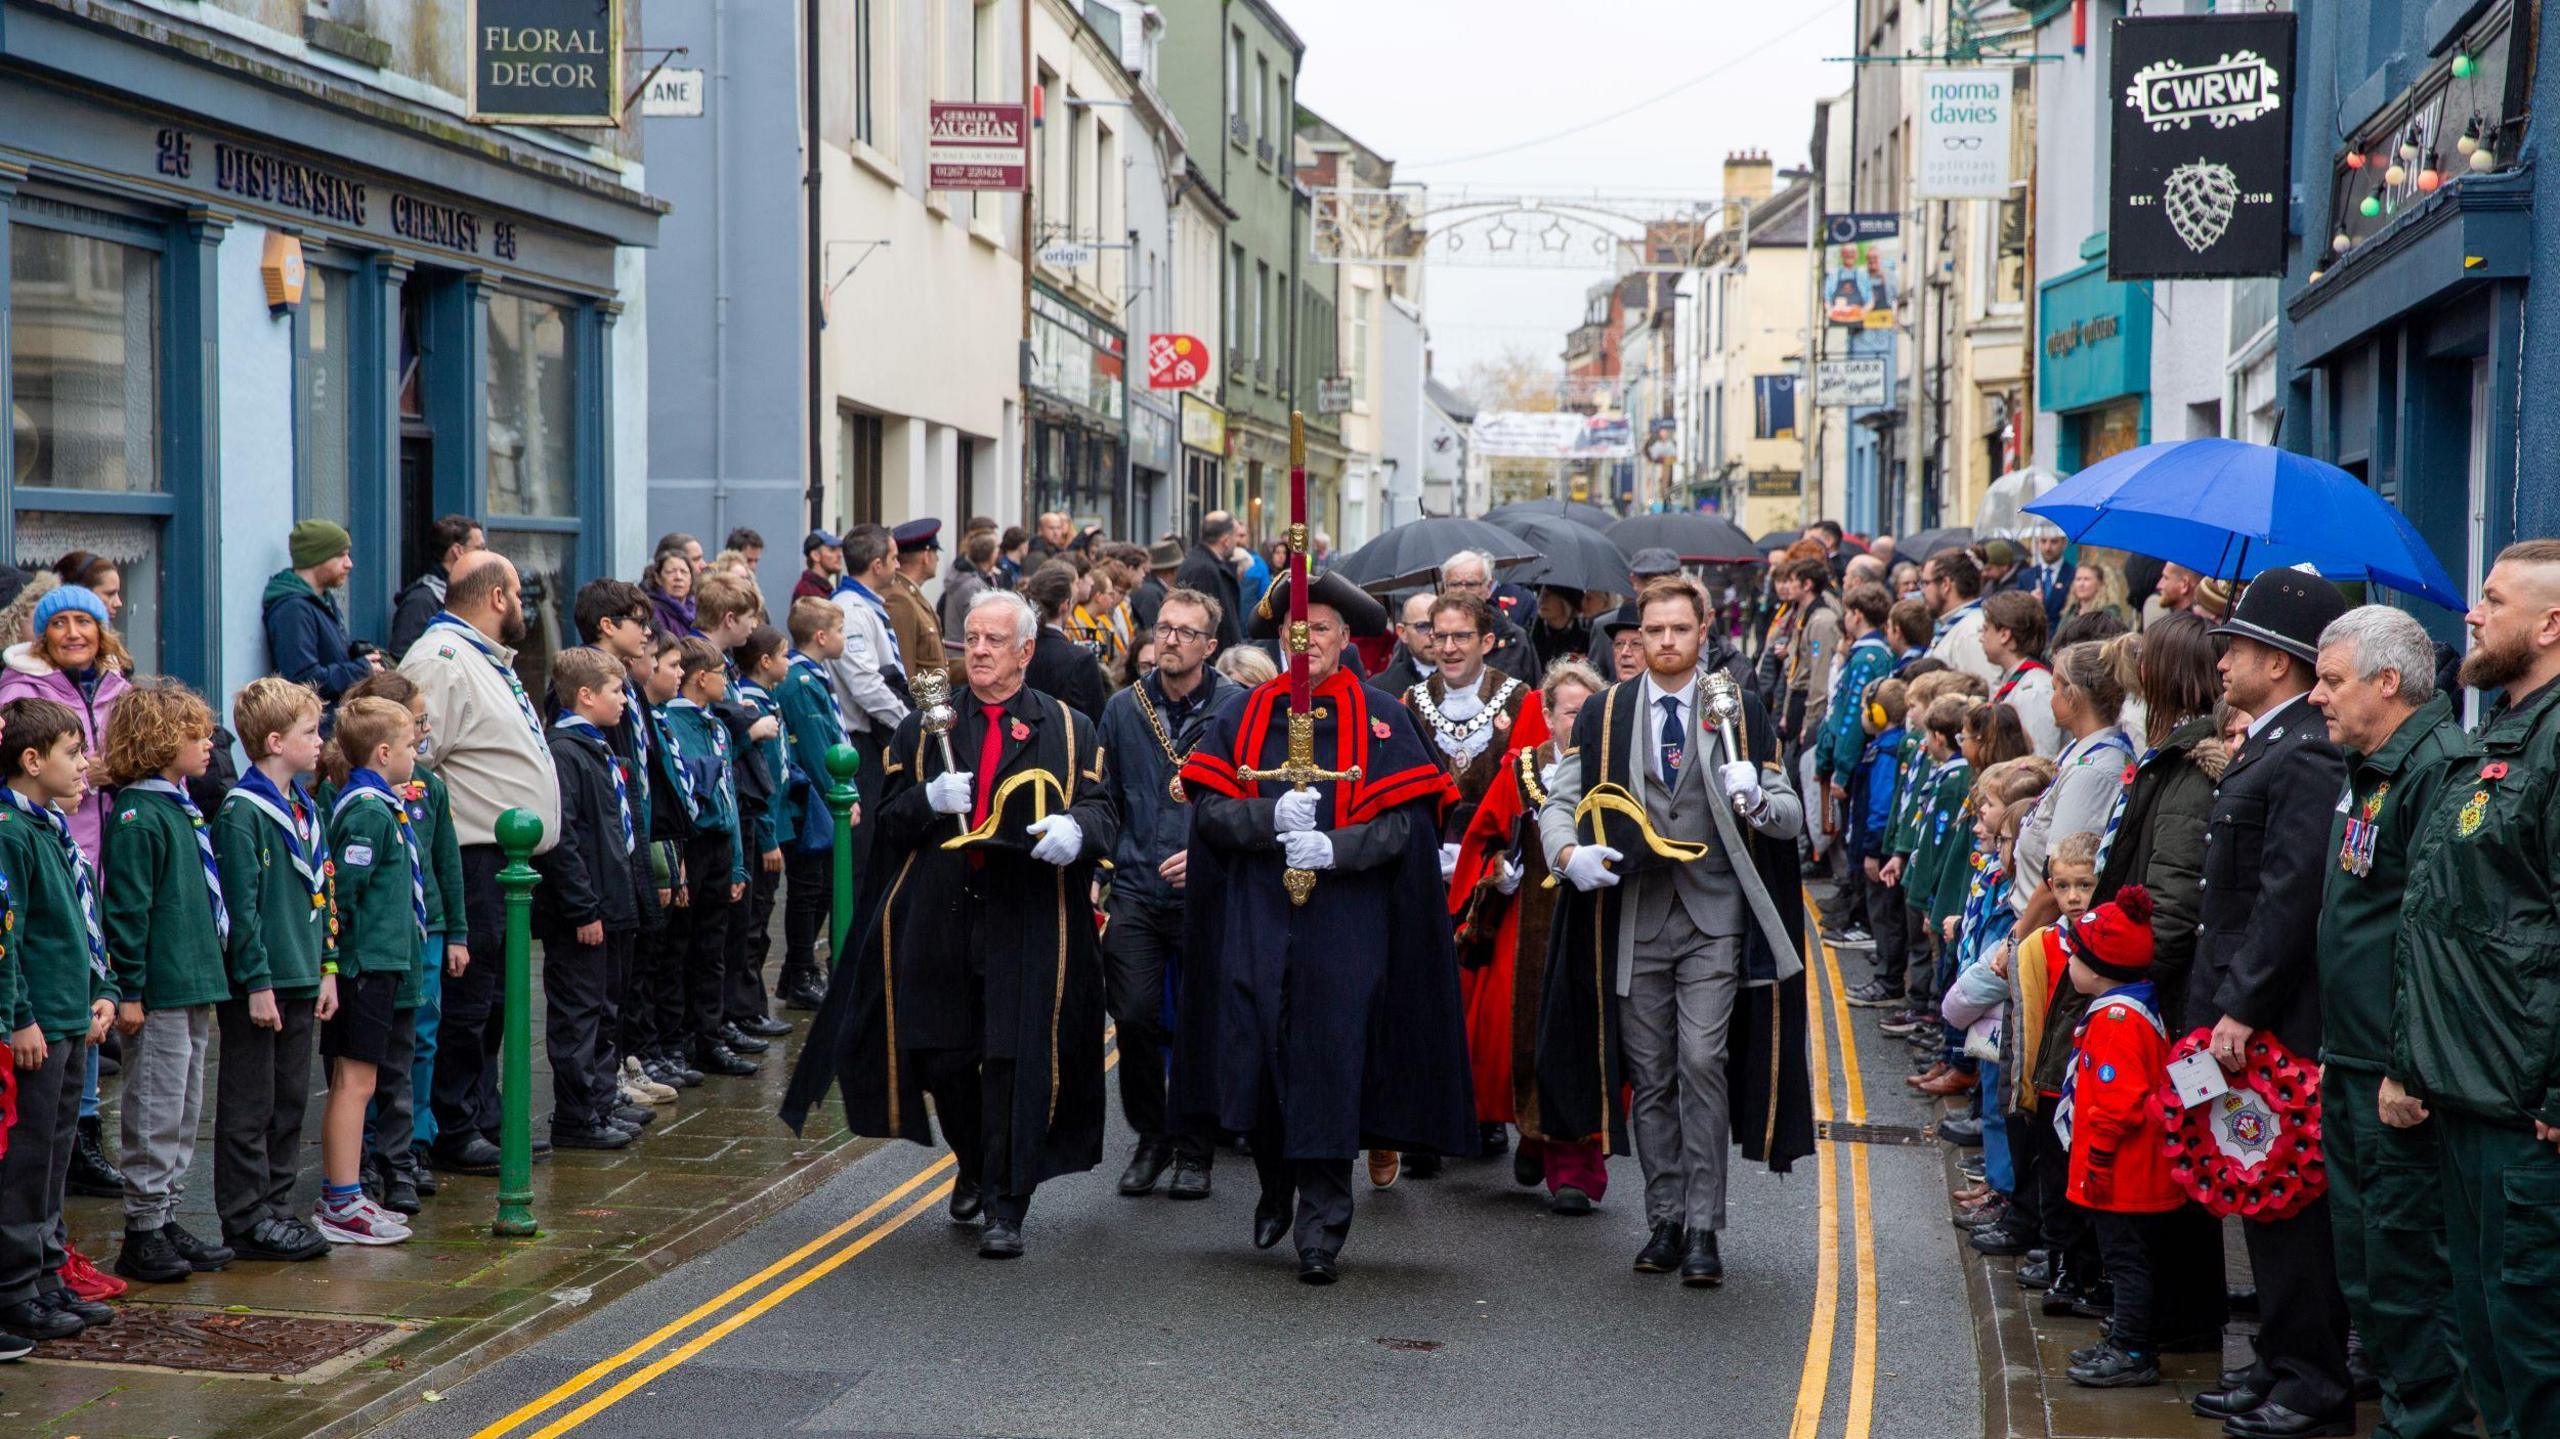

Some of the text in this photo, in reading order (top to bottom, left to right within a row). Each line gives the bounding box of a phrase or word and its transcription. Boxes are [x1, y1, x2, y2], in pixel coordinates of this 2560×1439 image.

[484, 26, 604, 54] FLORAL
[491, 62, 597, 89] DECOR
[1931, 83, 2000, 100] norma
[2151, 68, 2258, 112] CWRW
[942, 110, 987, 121] GERALD
[1931, 102, 1997, 124] davies
[930, 117, 1018, 137] VAUGHAN
[157, 129, 517, 261] 25 DISPENSING CHEMIST 25
[2130, 193, 2273, 206] EST. 2018
[1045, 249, 1088, 264] origin
[1150, 345, 1179, 377] LET
